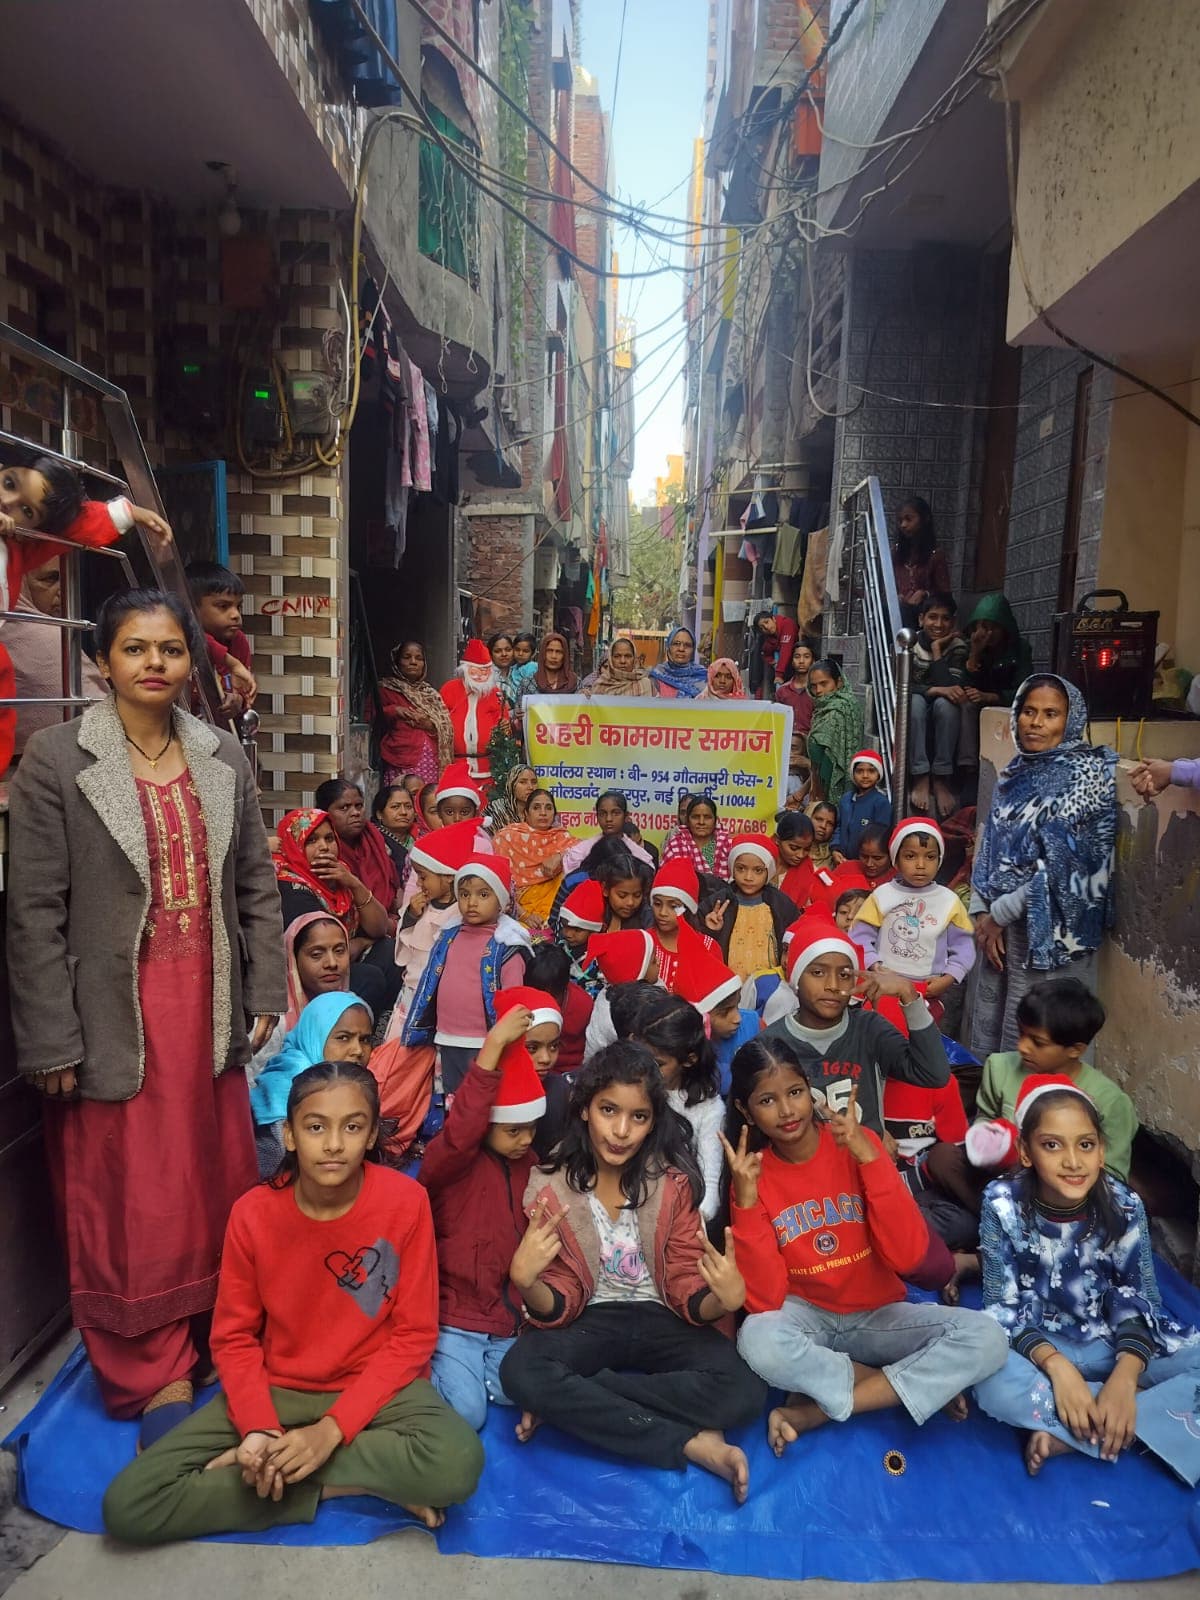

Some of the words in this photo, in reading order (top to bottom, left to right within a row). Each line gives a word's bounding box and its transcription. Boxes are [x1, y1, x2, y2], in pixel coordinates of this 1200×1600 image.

[536, 714, 593, 747] शहरी
[599, 724, 694, 750] कामगार
[698, 728, 774, 753] समाज
[534, 761, 584, 779] कार्यालय
[587, 766, 617, 780] स्थान
[651, 770, 669, 783] 954
[767, 776, 773, 789] 2
[655, 786, 674, 805] नई
[771, 1192, 866, 1248] CHICAGO
[808, 1263, 825, 1275] LEVEL
[826, 1256, 852, 1270] PREMIER
